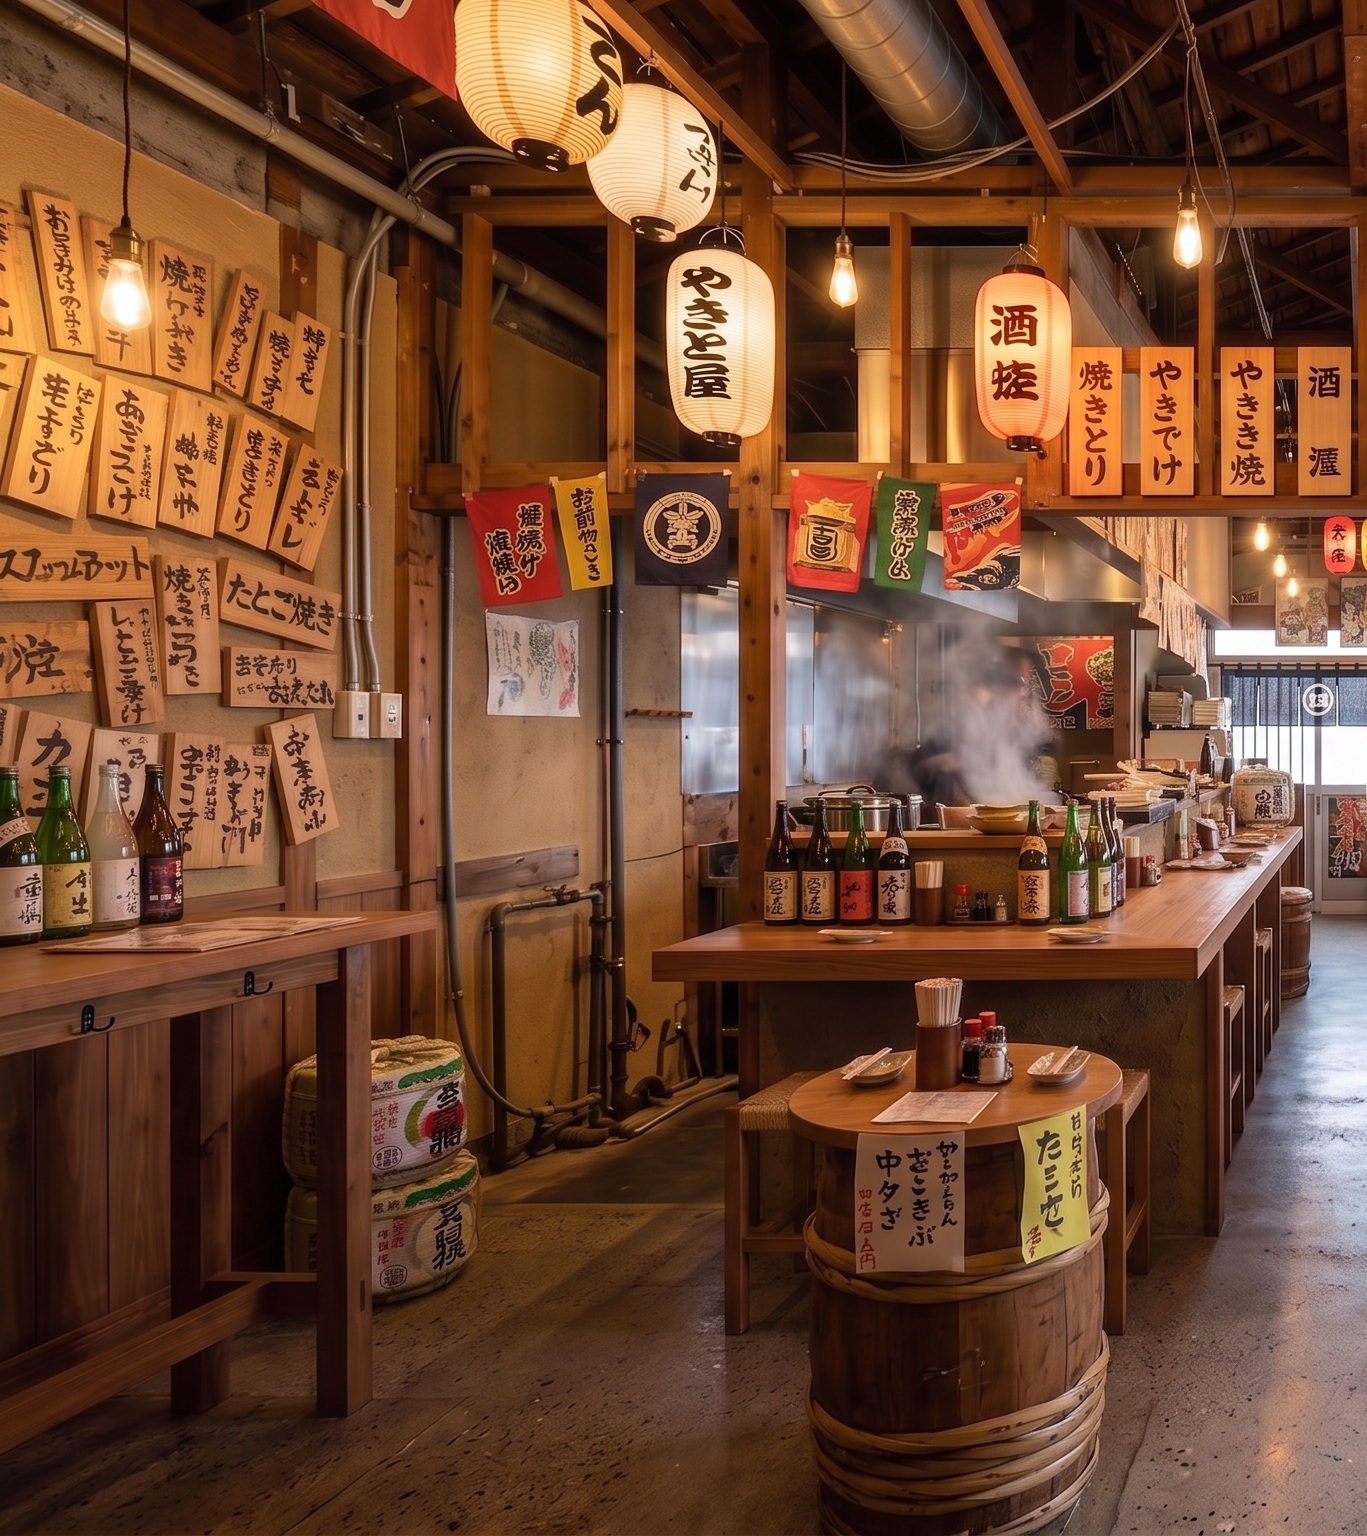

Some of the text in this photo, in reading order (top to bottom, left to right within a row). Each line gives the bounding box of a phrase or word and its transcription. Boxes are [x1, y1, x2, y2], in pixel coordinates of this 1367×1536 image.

[680, 266, 732, 400] やきと屋
[1079, 360, 1113, 486] 焼きとり
[1150, 360, 1182, 486] やきでけ
[1230, 360, 1266, 486] やきき焼
